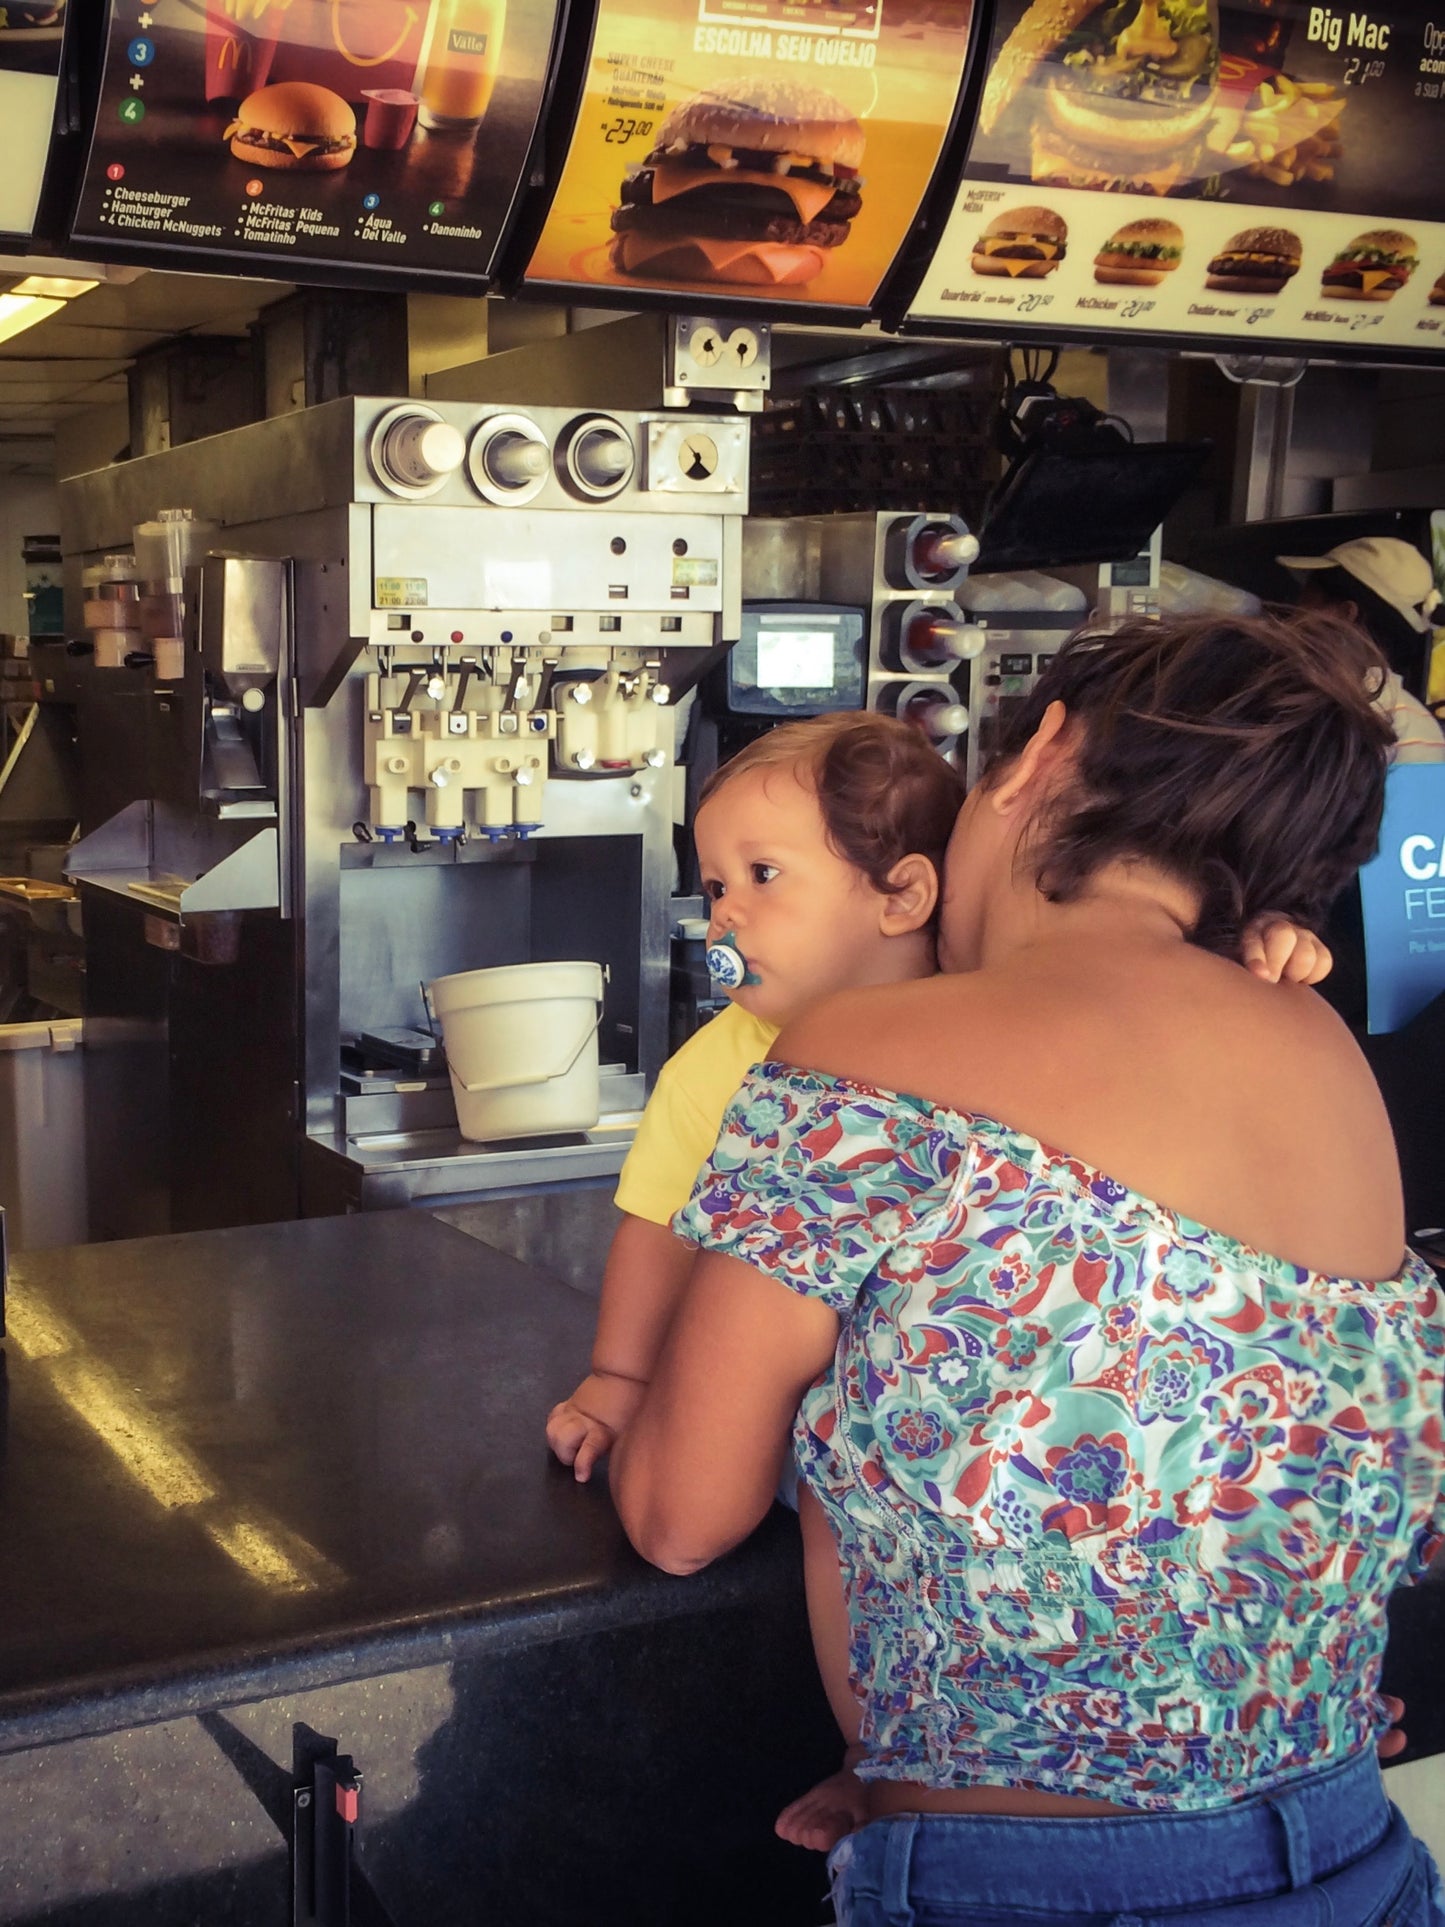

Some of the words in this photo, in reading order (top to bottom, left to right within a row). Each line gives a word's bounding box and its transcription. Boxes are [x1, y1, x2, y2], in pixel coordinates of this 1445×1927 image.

[1307, 6, 1343, 52] Big
[1346, 12, 1391, 50] Mac
[134, 42, 148, 62] 3
[452, 33, 484, 51] Valle
[694, 25, 772, 59] ESCOLHA
[776, 34, 811, 62] SEU
[814, 38, 877, 69] QUEIJO
[124, 101, 137, 120] 4
[114, 186, 191, 208] Cheeseburger
[111, 200, 173, 219] Hamburger
[249, 201, 296, 219] McFritas
[299, 207, 324, 222] Kids
[107, 213, 116, 226] 4
[117, 214, 161, 230] Chicken
[162, 219, 222, 238] McNuggets
[245, 215, 292, 231] McFritas
[295, 220, 341, 237] Pequena
[365, 212, 393, 230] Água
[429, 222, 482, 239] Danoninho
[243, 228, 297, 245] Tomatinho
[361, 228, 380, 241] Del
[381, 229, 407, 244] Valle
[1400, 834, 1445, 881] C
[1405, 887, 1445, 920] FE
